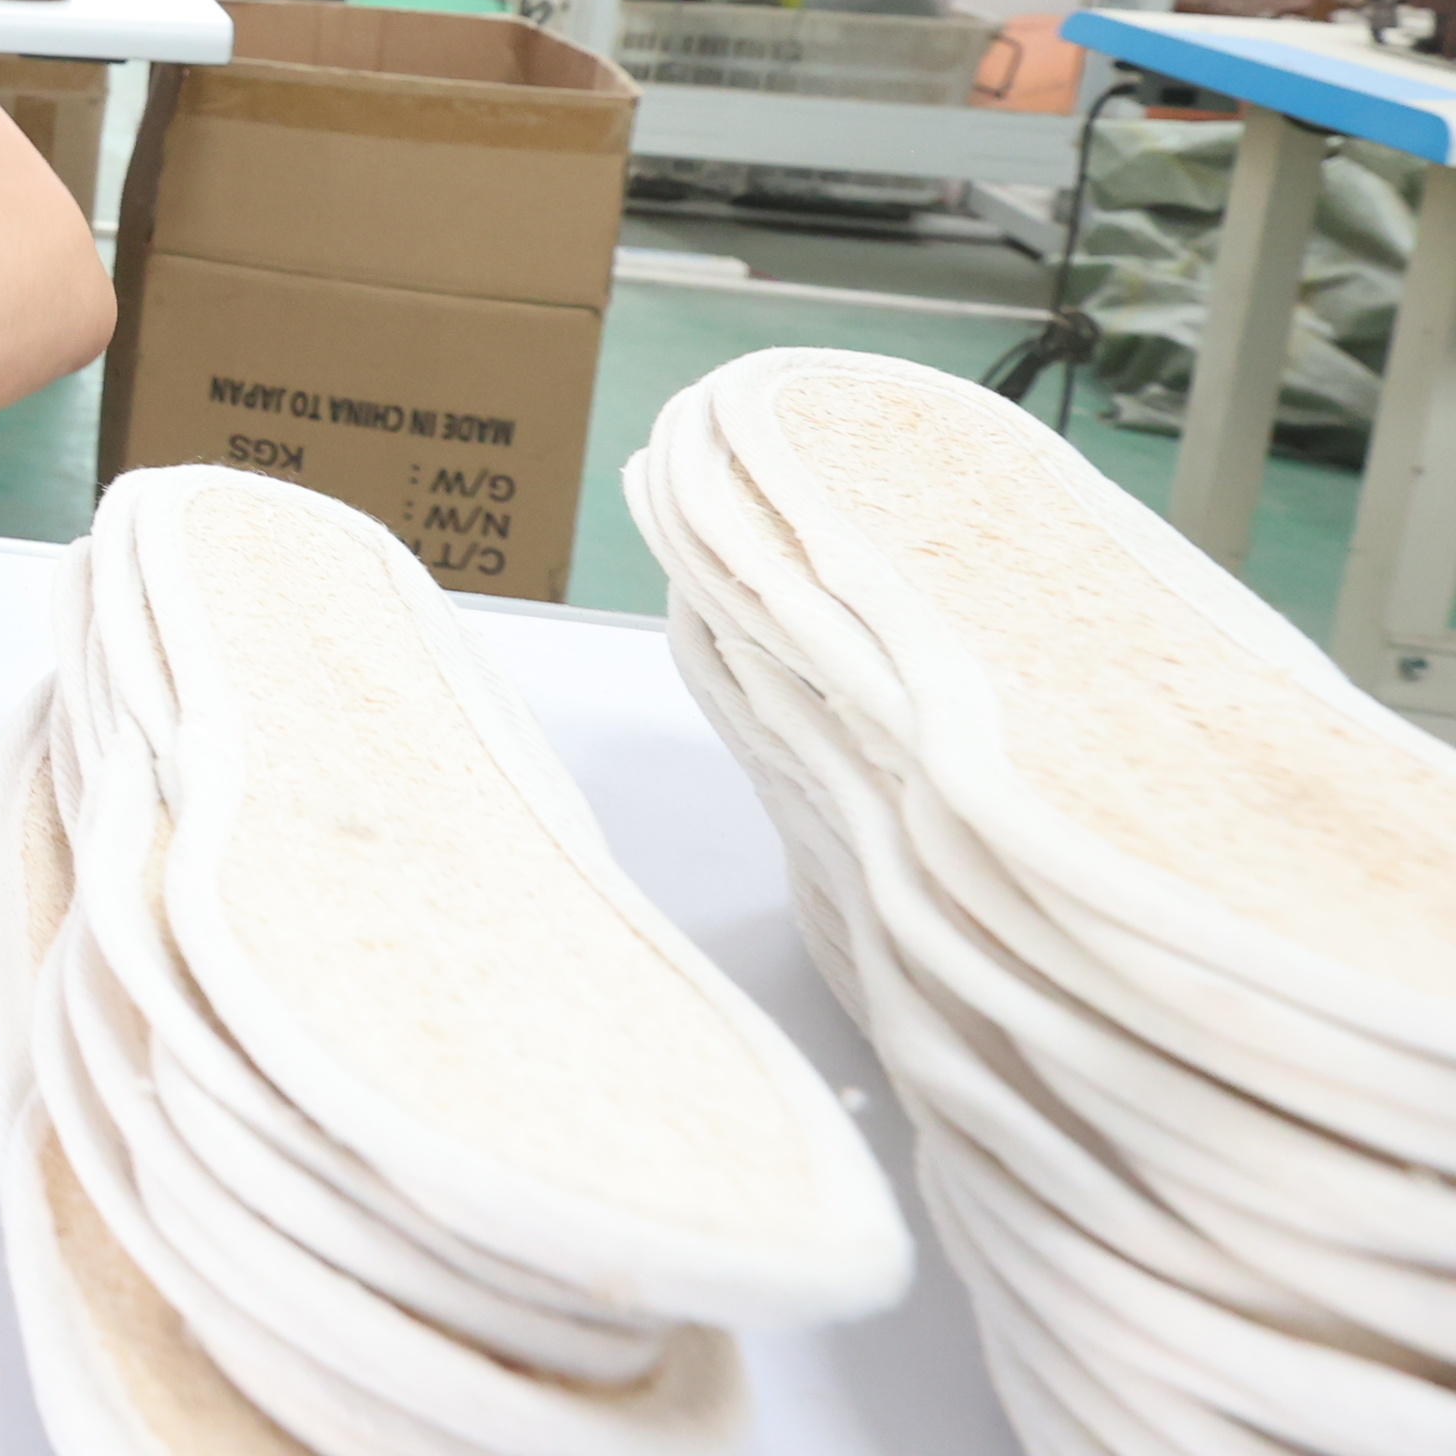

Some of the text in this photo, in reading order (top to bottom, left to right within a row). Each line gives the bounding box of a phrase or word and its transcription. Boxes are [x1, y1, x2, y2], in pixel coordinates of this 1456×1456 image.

[210, 377, 515, 446] MADE IN CHINA TO JAPAN
[229, 434, 303, 471] KGS
[433, 543, 505, 575] C/T
